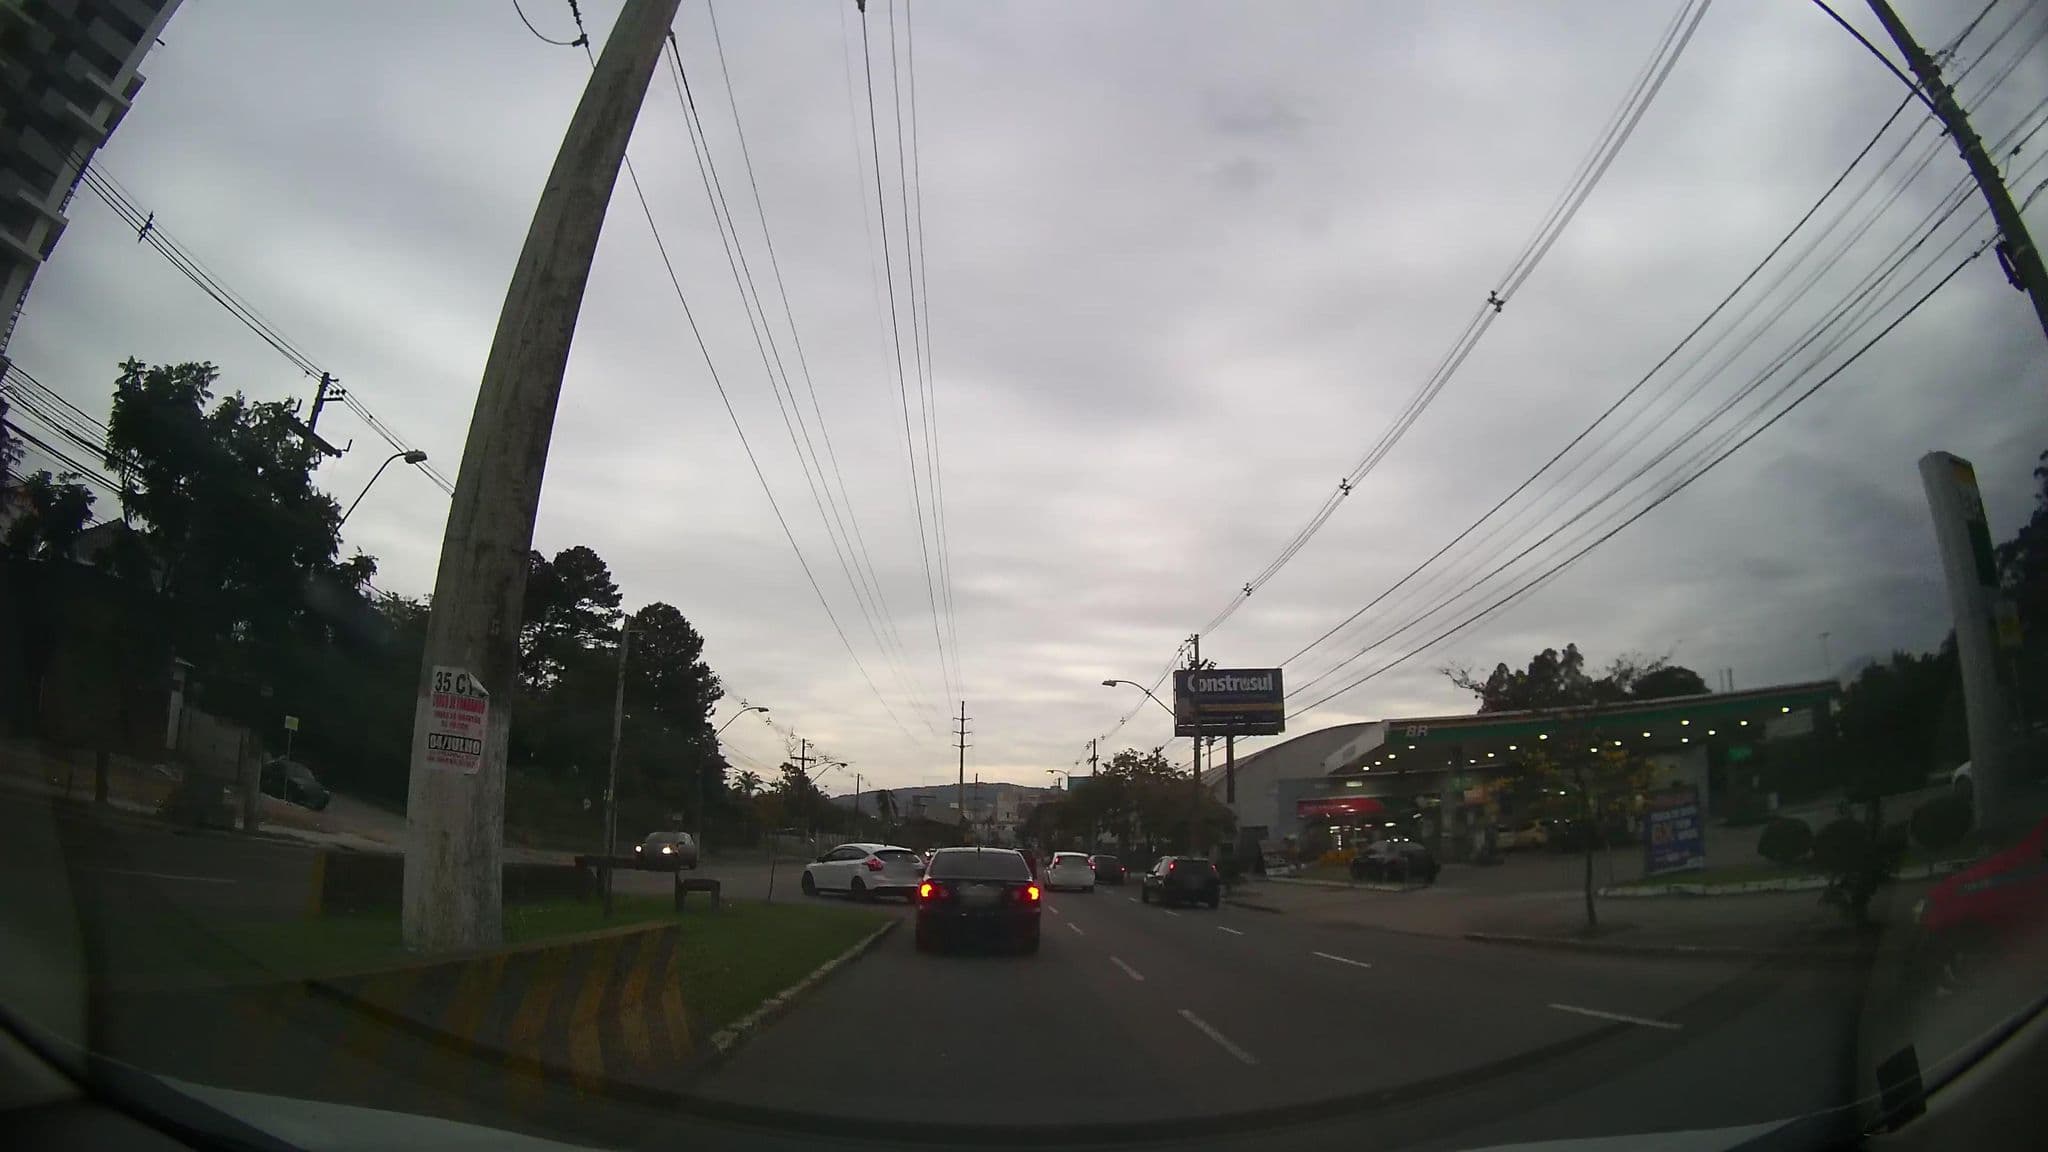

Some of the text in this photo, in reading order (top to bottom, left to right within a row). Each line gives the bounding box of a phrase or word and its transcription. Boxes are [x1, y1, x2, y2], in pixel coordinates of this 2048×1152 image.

[435, 671, 452, 692] 35
[1187, 672, 1273, 692] Construsul
[1406, 725, 1428, 736] BR
